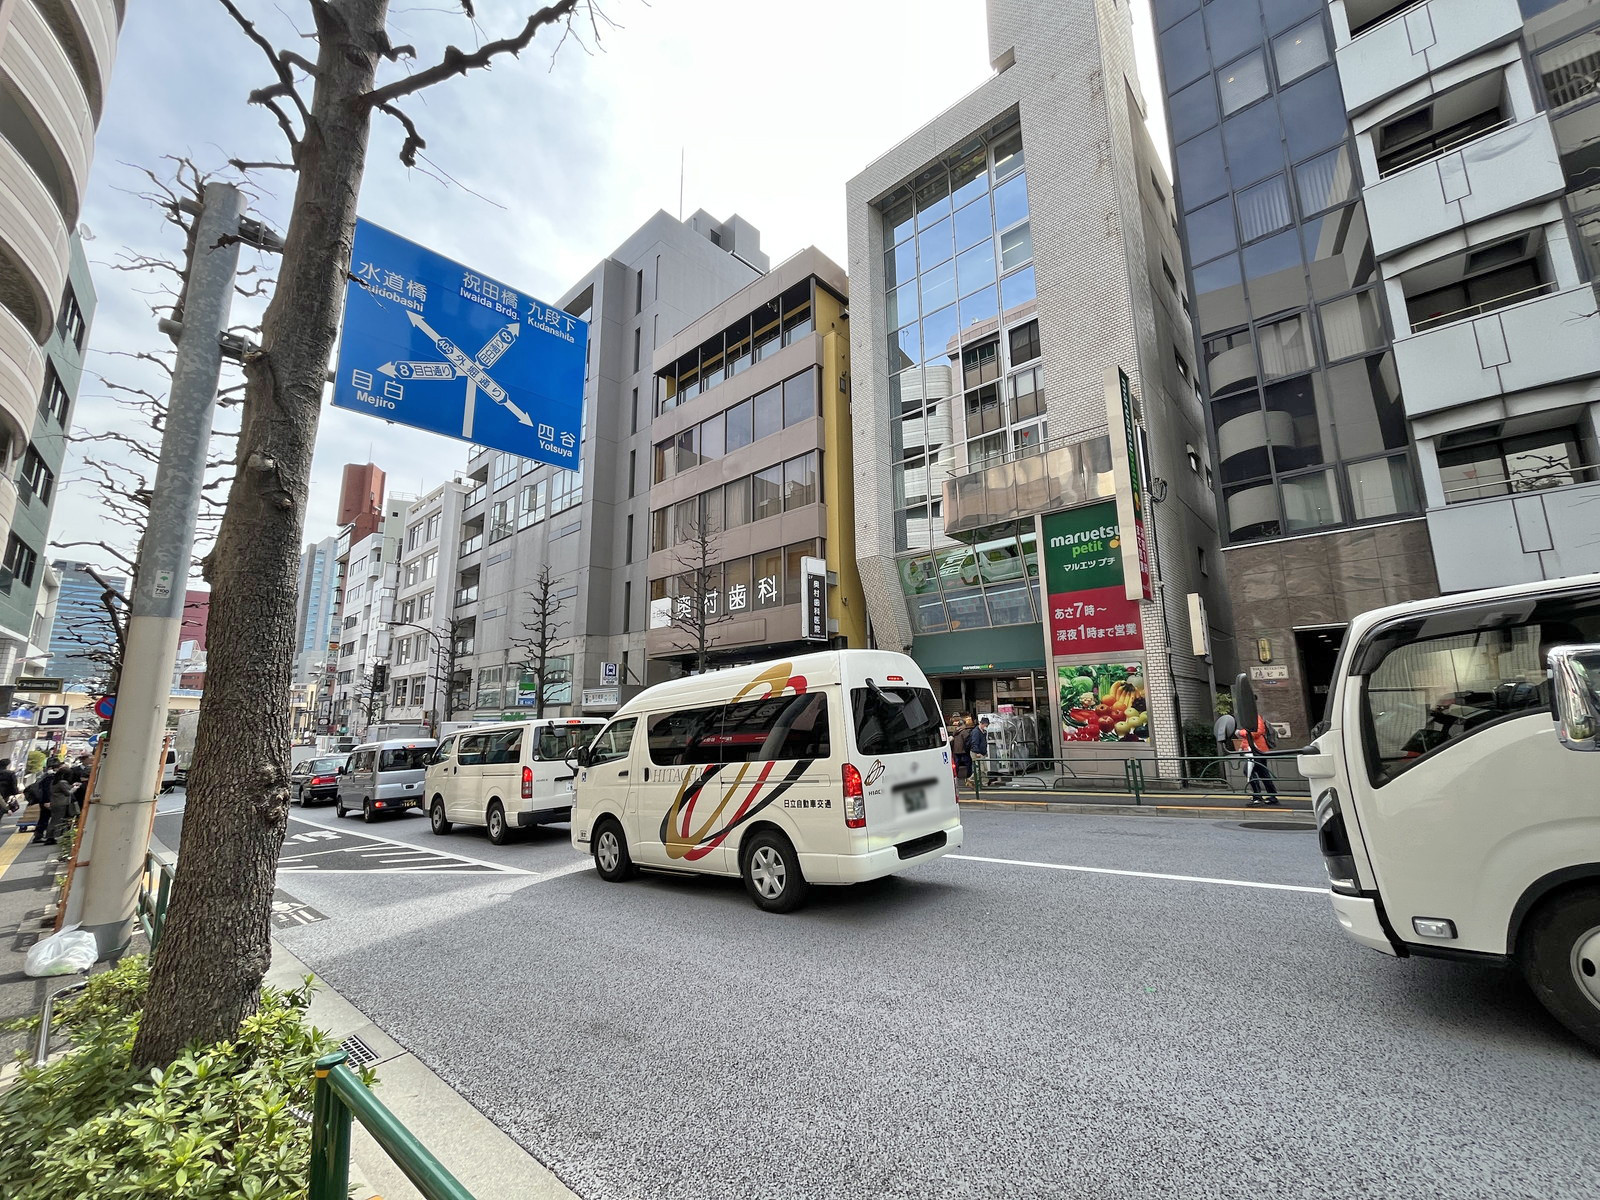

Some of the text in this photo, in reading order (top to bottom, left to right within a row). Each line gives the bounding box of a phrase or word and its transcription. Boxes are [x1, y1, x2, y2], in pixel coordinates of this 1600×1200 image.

[358, 261, 427, 302] 水道橋
[463, 271, 519, 309] 祝田橋
[460, 287, 520, 320] Iwaida Brdg.
[527, 302, 577, 331] 九段下
[501, 331, 511, 342] 8
[527, 317, 575, 343] Kudanshita
[438, 340, 453, 354] 405
[480, 339, 504, 365] 目白通り
[400, 365, 409, 376] 8
[413, 365, 451, 376] 目白通り
[453, 354, 502, 398] 外堀通り
[352, 368, 404, 400] 目白
[356, 390, 396, 410] Mejiro
[537, 423, 576, 448] 四谷
[539, 440, 573, 457] Yotsuya
[1072, 540, 1103, 558] petit
[1063, 557, 1116, 572] マルエツ プチ
[1056, 623, 1137, 641] 深夜1時まで営業
[41, 707, 65, 724] P
[784, 799, 832, 809] 日立自動車交通
